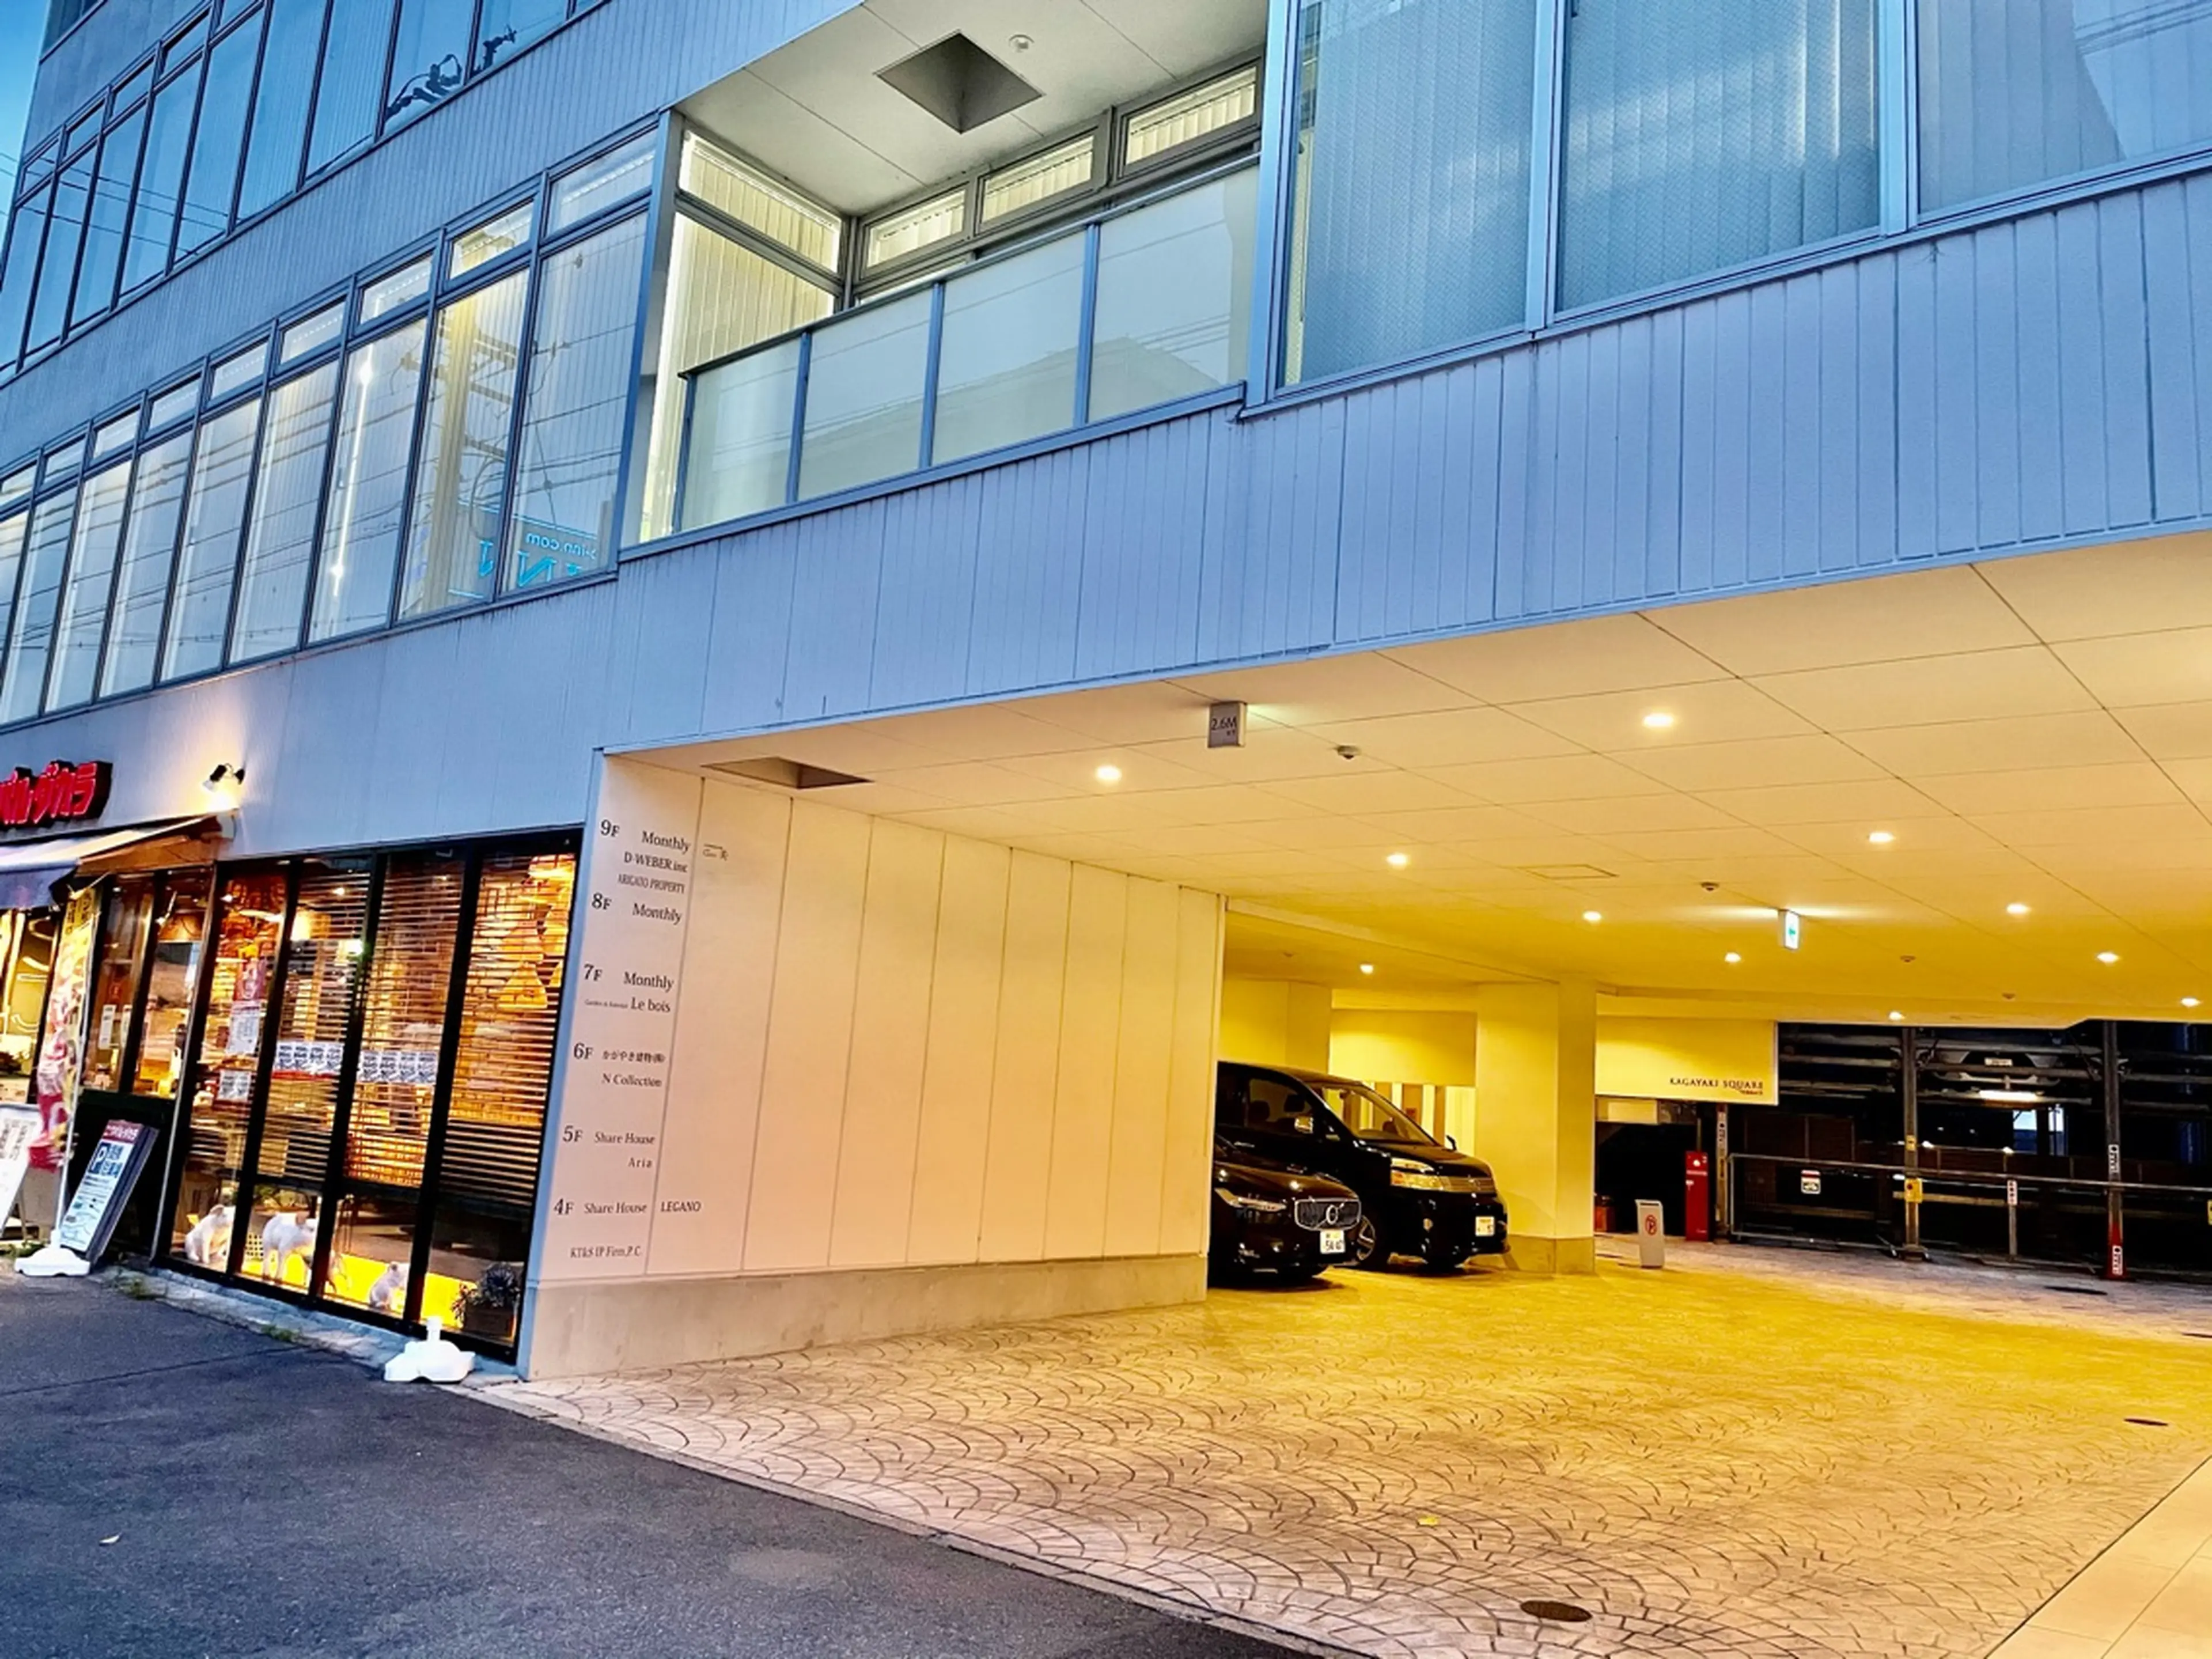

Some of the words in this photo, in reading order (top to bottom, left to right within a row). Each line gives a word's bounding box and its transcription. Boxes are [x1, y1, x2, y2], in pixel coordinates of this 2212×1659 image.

[601, 819, 620, 838] 9F
[642, 830, 691, 855] Monthly
[650, 878, 685, 893] PROPERTY
[592, 892, 612, 910] 8F
[632, 903, 682, 925] Monthly
[584, 963, 603, 982] 7F
[623, 971, 675, 993] Monthly
[631, 997, 646, 1011] Le
[648, 998, 671, 1013] bois
[574, 1042, 593, 1059] 6F
[602, 1073, 611, 1084] N
[613, 1074, 662, 1087] Collection
[1670, 1078, 1718, 1088] KAGAYAKI
[1723, 1080, 1763, 1090] SQUARE
[562, 1125, 583, 1143] 5F
[594, 1131, 623, 1143] Share
[624, 1132, 656, 1145] House
[628, 1157, 652, 1168] Aria
[554, 1198, 574, 1215] 4F
[584, 1203, 614, 1214] Share
[616, 1202, 647, 1214] House
